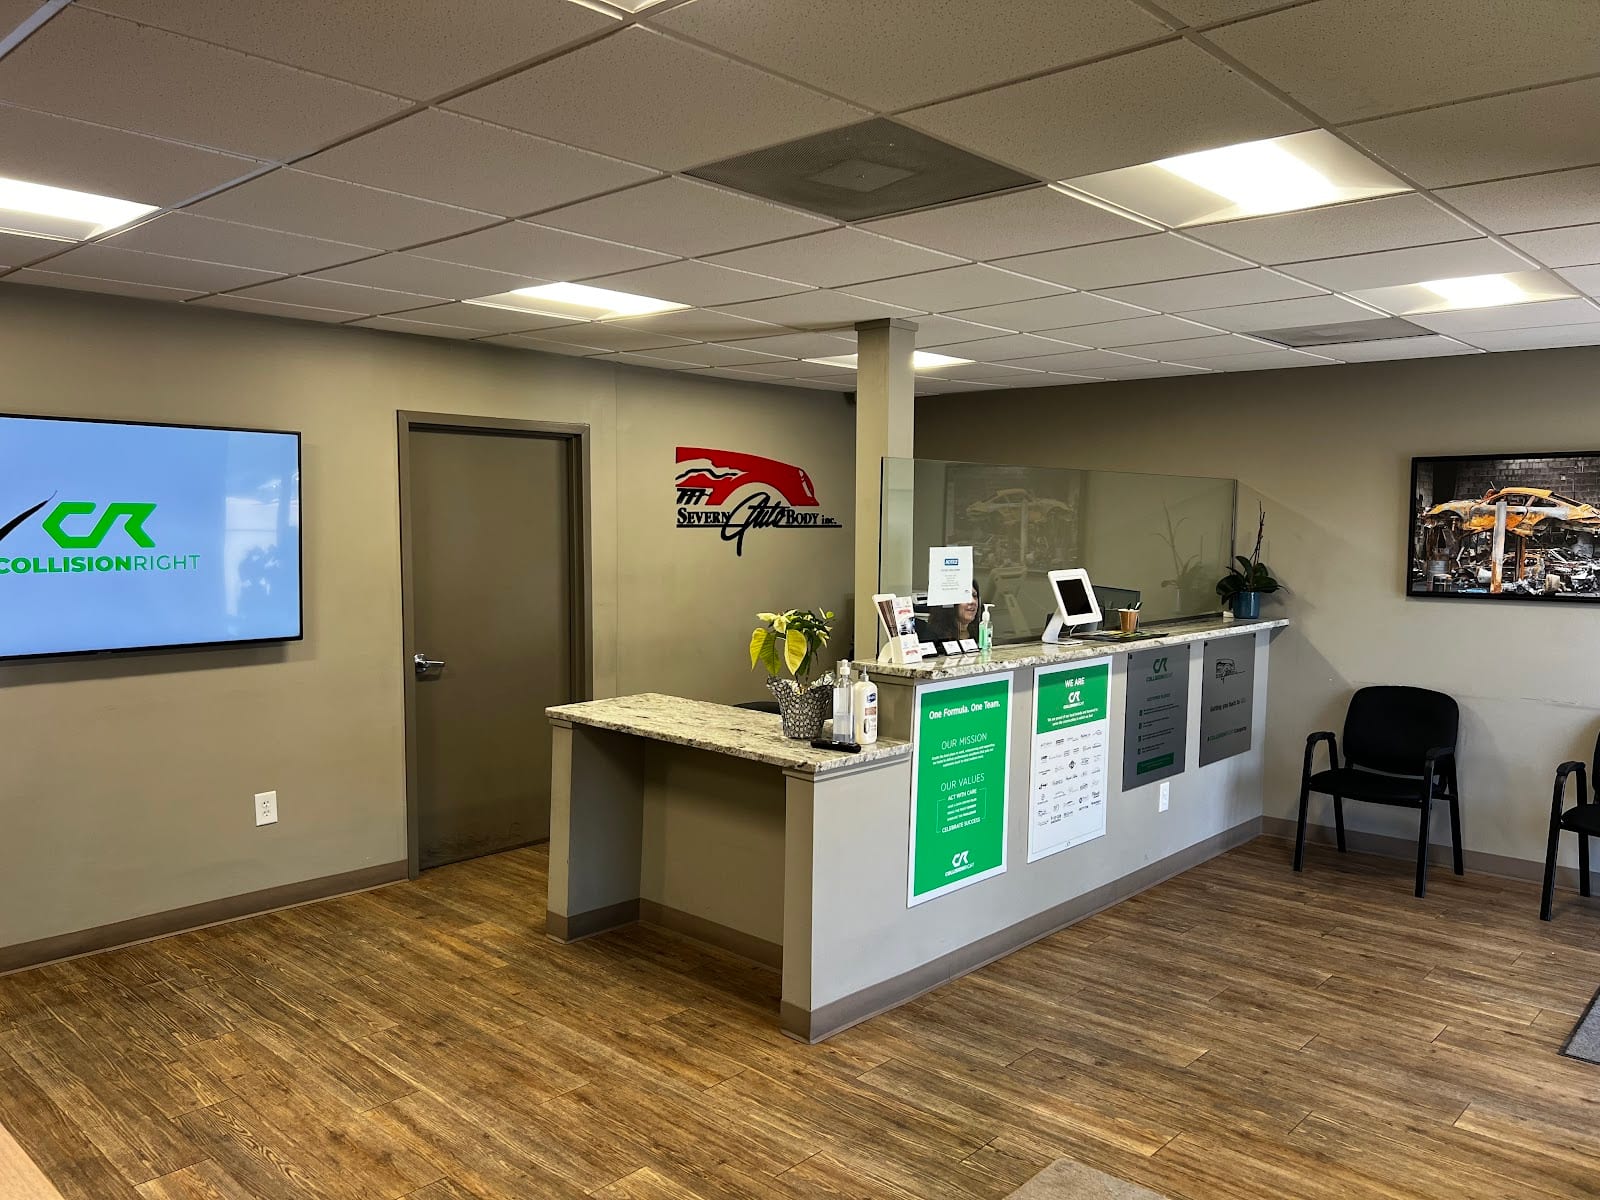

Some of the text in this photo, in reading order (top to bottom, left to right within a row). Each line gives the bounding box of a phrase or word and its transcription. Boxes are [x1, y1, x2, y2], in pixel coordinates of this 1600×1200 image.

[677, 508, 730, 524] SEVERN
[786, 509, 819, 525] BODY
[0, 555, 200, 575] COLLISIONRIGHT
[1065, 677, 1085, 688] WE ARE
[929, 700, 1000, 719] One Formula. One Team.
[941, 732, 988, 750] OUR MISSION
[940, 772, 985, 792] OUR VALUES
